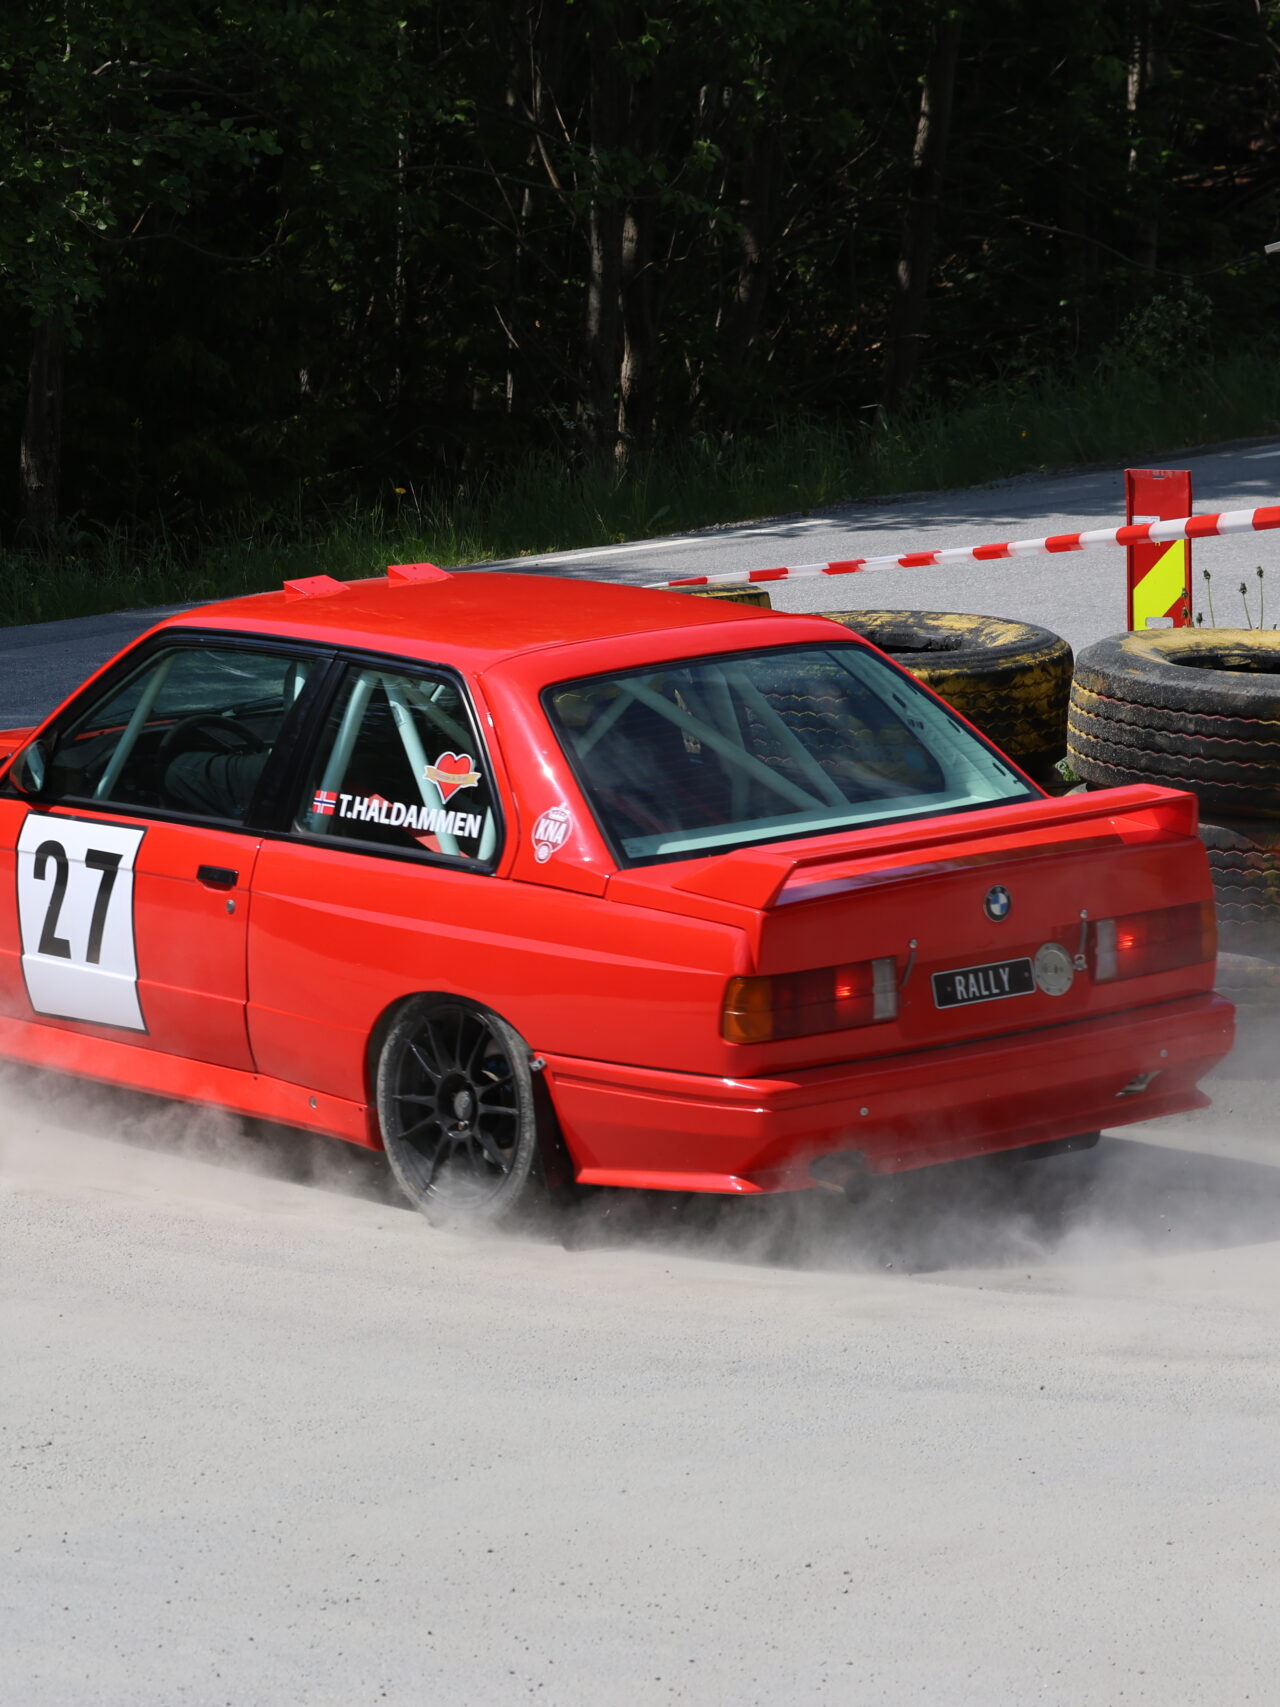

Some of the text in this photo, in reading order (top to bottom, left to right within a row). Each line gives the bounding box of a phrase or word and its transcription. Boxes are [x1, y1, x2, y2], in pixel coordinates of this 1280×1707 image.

[339, 793, 482, 838] T.HALDAMMEN
[535, 818, 568, 845] KNA
[33, 840, 124, 965] 27
[955, 967, 1010, 1000] RALLY
